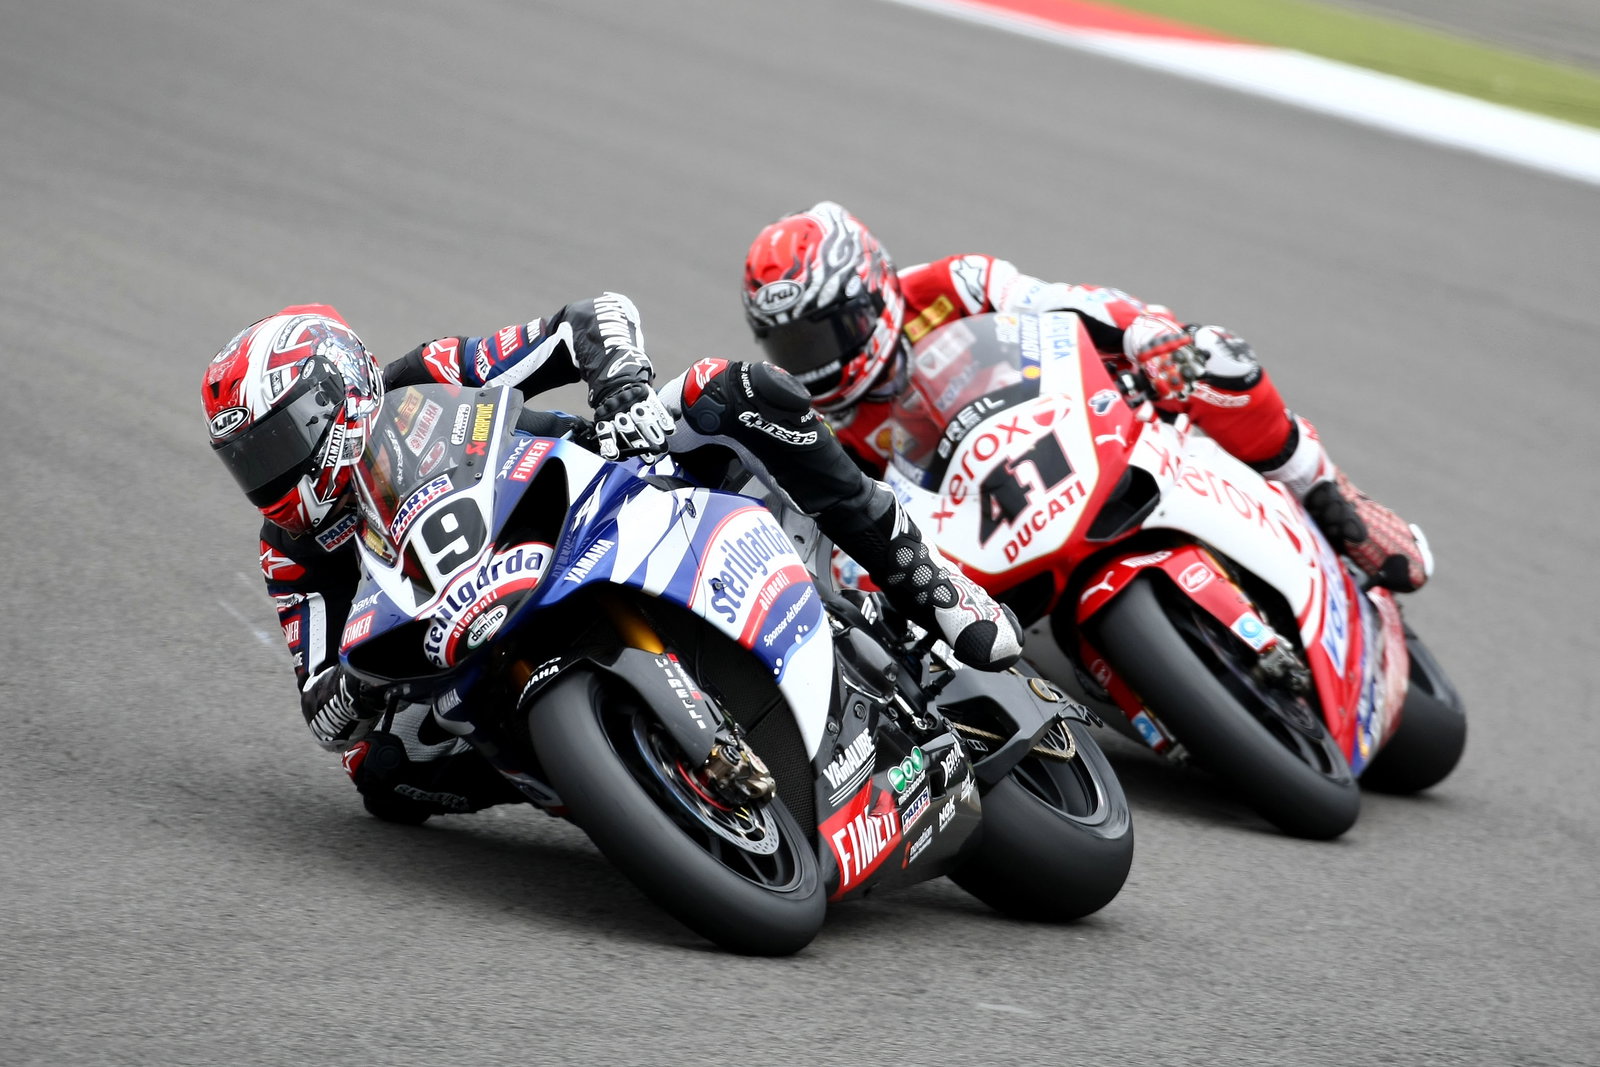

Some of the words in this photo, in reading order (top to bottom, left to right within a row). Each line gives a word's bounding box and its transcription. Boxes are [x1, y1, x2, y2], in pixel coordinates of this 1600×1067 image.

[325, 423, 346, 467] YAMAHA
[416, 404, 439, 443] YAMAHA
[513, 441, 551, 480] FIMER
[930, 415, 1032, 534] xerox
[391, 475, 449, 536] PARTS
[978, 429, 1076, 549] 41
[319, 513, 358, 543] PART
[325, 523, 358, 551] EURO
[421, 497, 488, 576] 9
[1002, 480, 1087, 564] DUCATI
[563, 538, 616, 584] YAMAHA
[759, 568, 791, 611] alimenti
[342, 615, 372, 647] FIMER
[452, 589, 498, 639] alimenti
[471, 610, 504, 642] domino
[903, 789, 928, 825] PARTS
[938, 794, 956, 825] NGK
